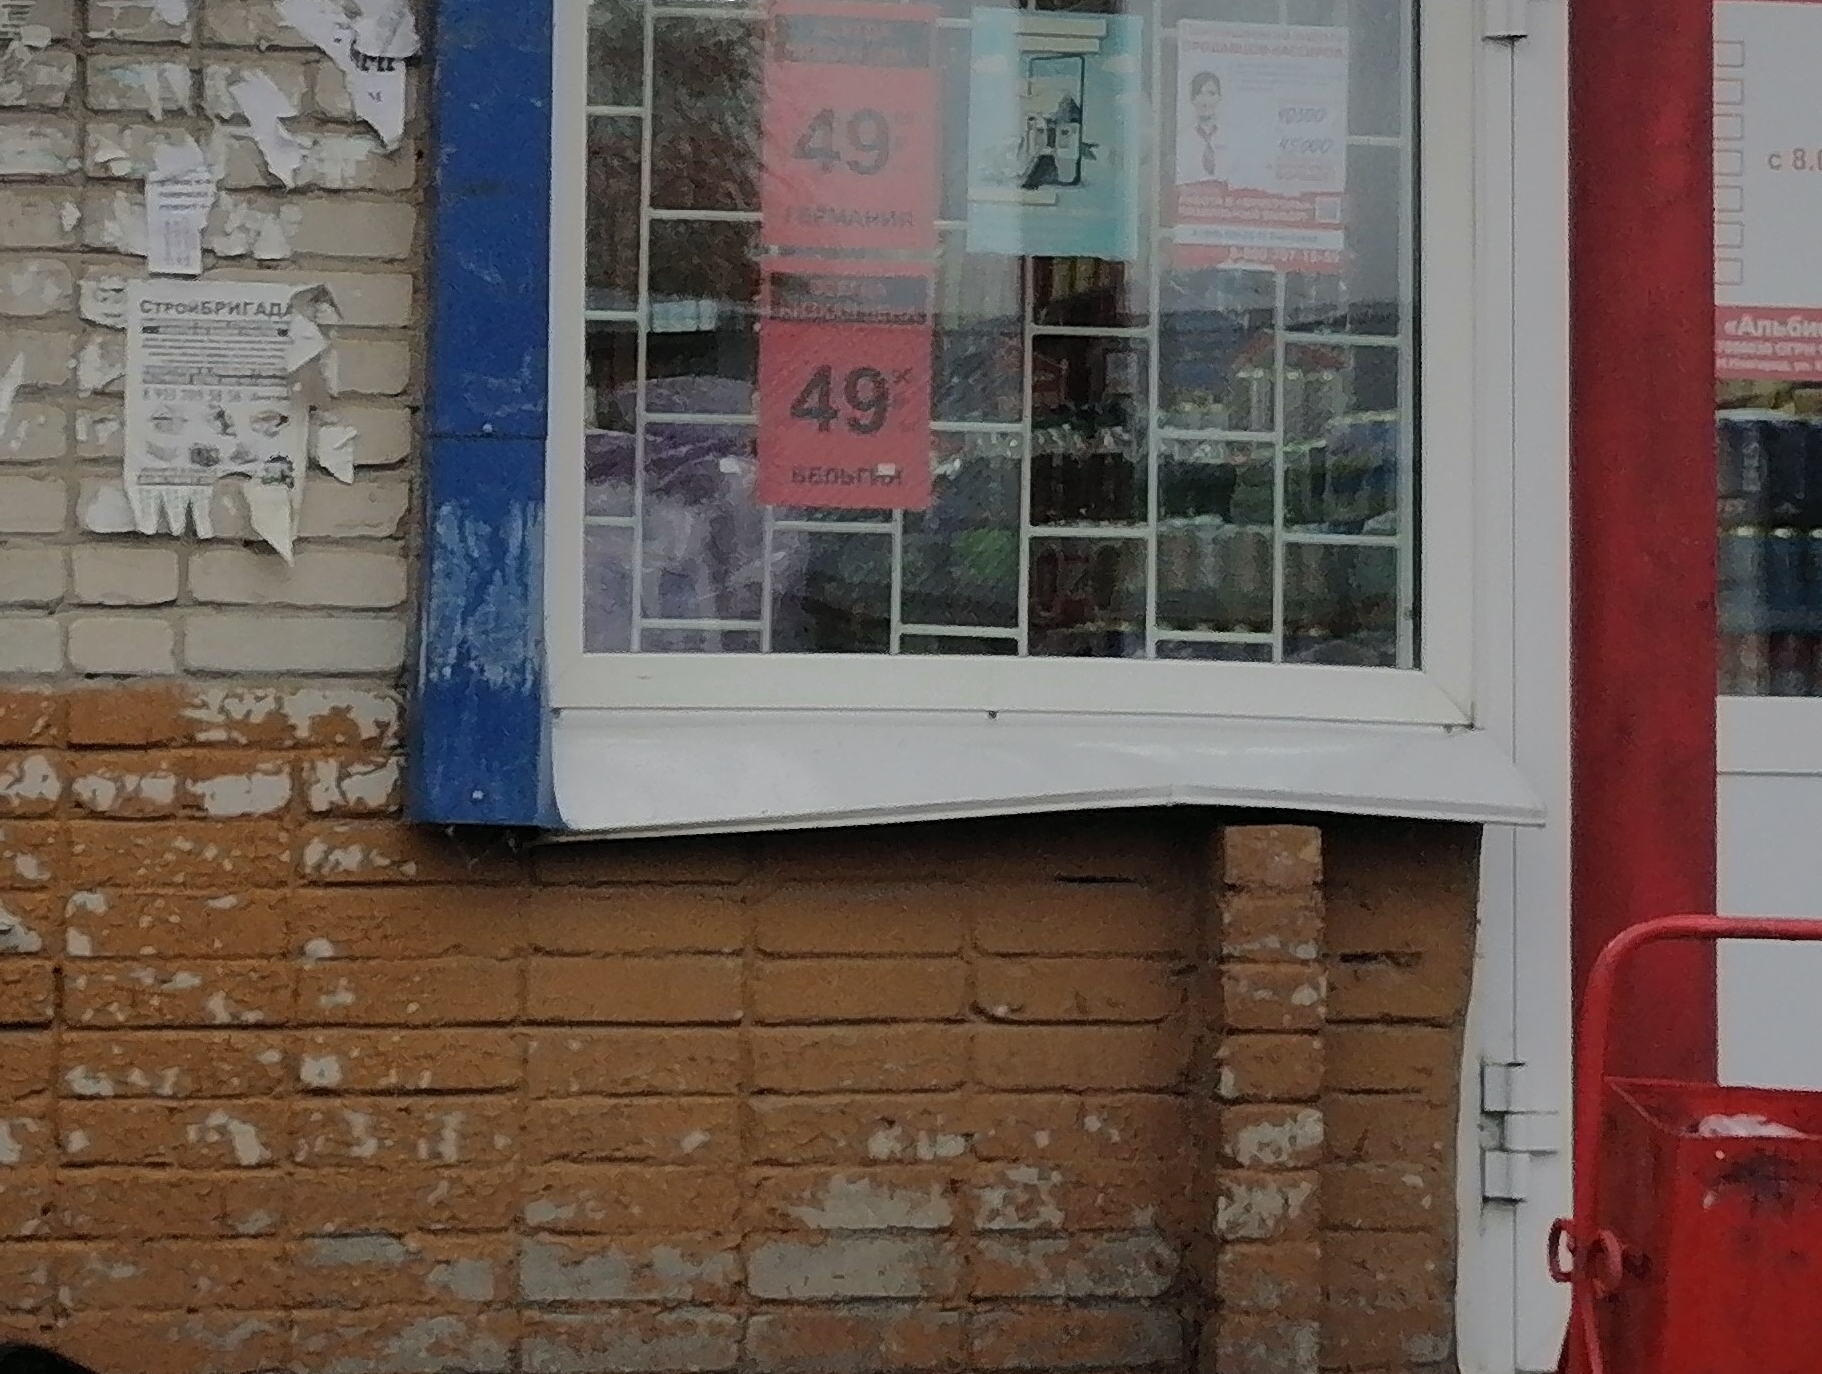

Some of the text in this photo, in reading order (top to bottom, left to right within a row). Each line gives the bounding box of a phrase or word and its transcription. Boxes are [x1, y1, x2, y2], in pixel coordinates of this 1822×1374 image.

[791, 107, 890, 176] 49
[1767, 153, 1782, 171] с
[790, 364, 890, 436] 49
